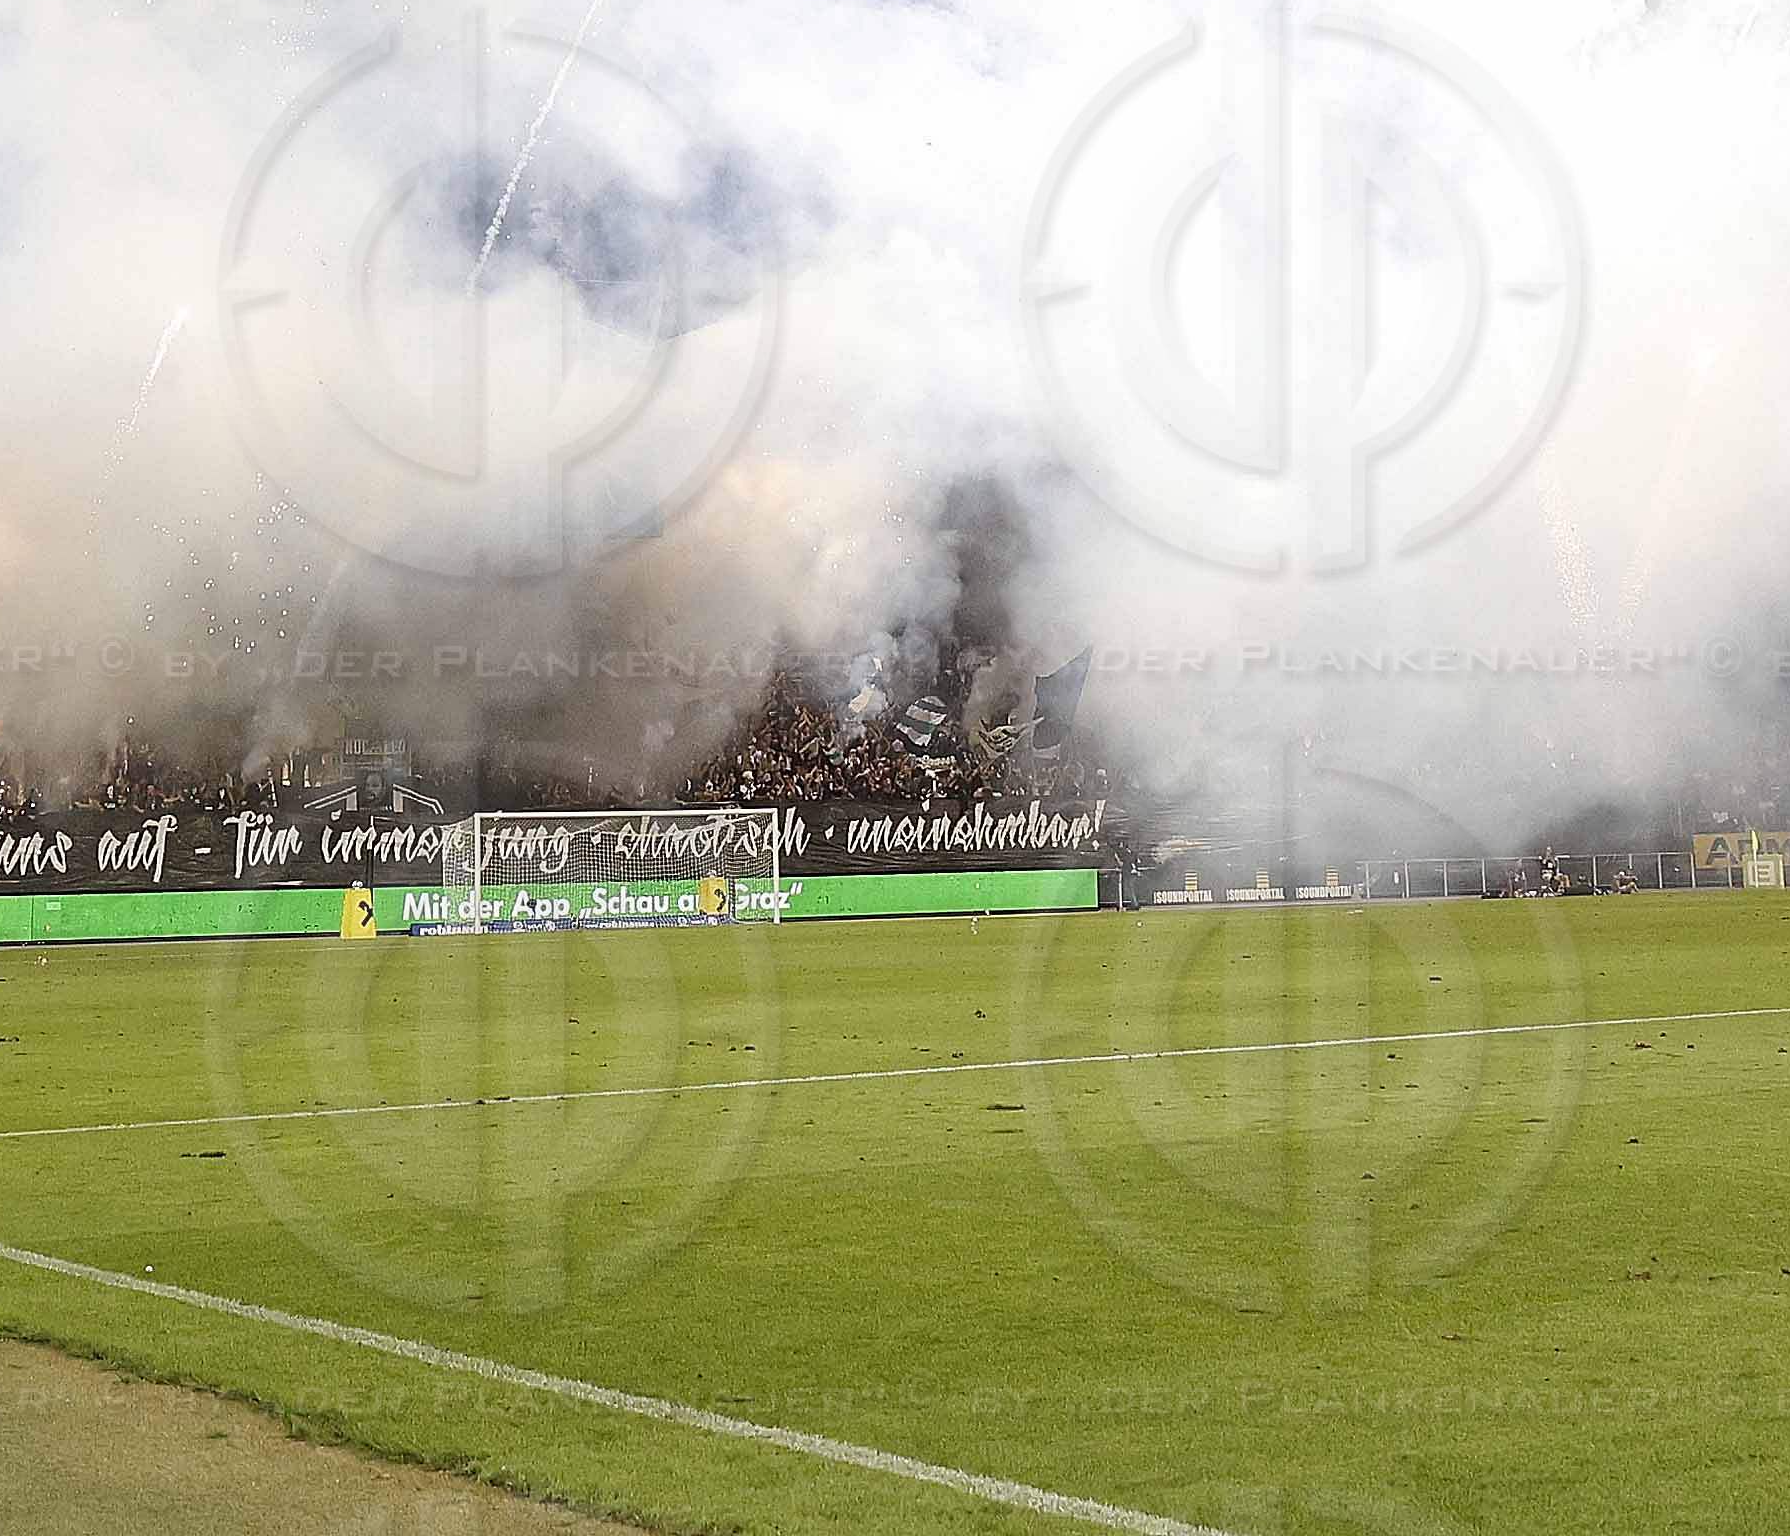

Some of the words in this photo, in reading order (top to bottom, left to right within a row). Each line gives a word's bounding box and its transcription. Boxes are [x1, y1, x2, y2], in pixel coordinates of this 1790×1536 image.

[97, 814, 178, 883] auf
[222, 810, 303, 879] für
[403, 892, 451, 921] Mit
[458, 890, 504, 920] der
[511, 889, 570, 921] App
